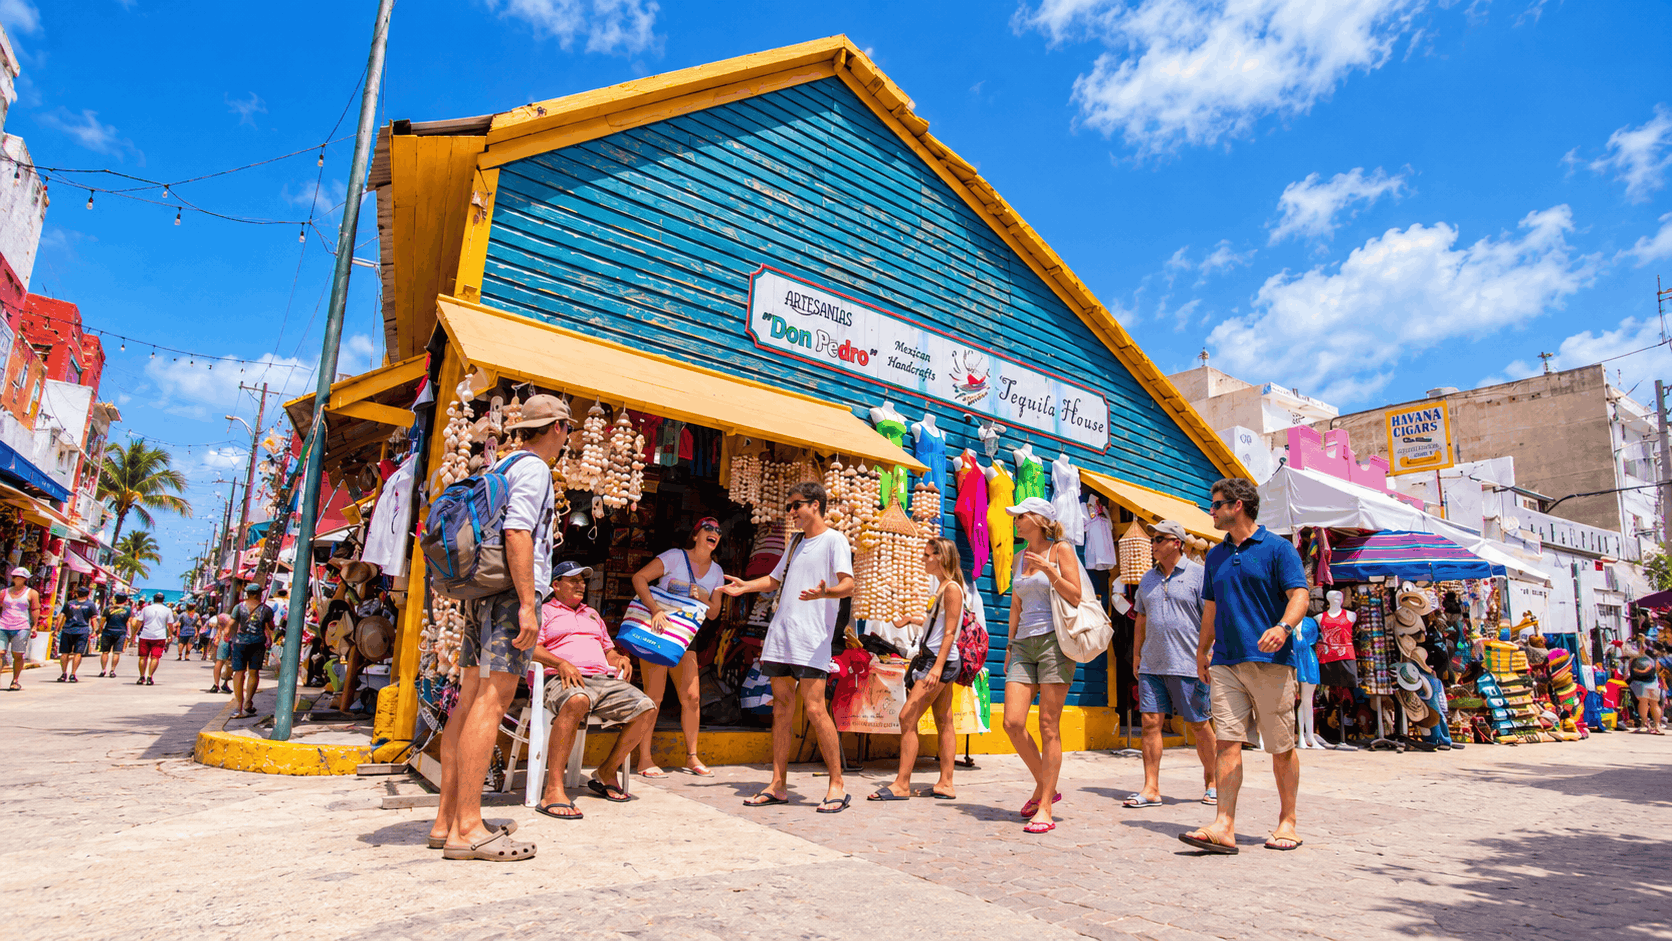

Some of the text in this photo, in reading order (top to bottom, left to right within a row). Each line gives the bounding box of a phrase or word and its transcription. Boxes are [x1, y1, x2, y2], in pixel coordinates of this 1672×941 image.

[784, 290, 853, 327] ARTESANIAS
[894, 340, 931, 363] Mexican
[887, 355, 936, 382] Handcrafts
[998, 375, 1105, 433] Tequila House
[1391, 408, 1442, 427] HAVANA
[1393, 421, 1438, 438] CIGARS
